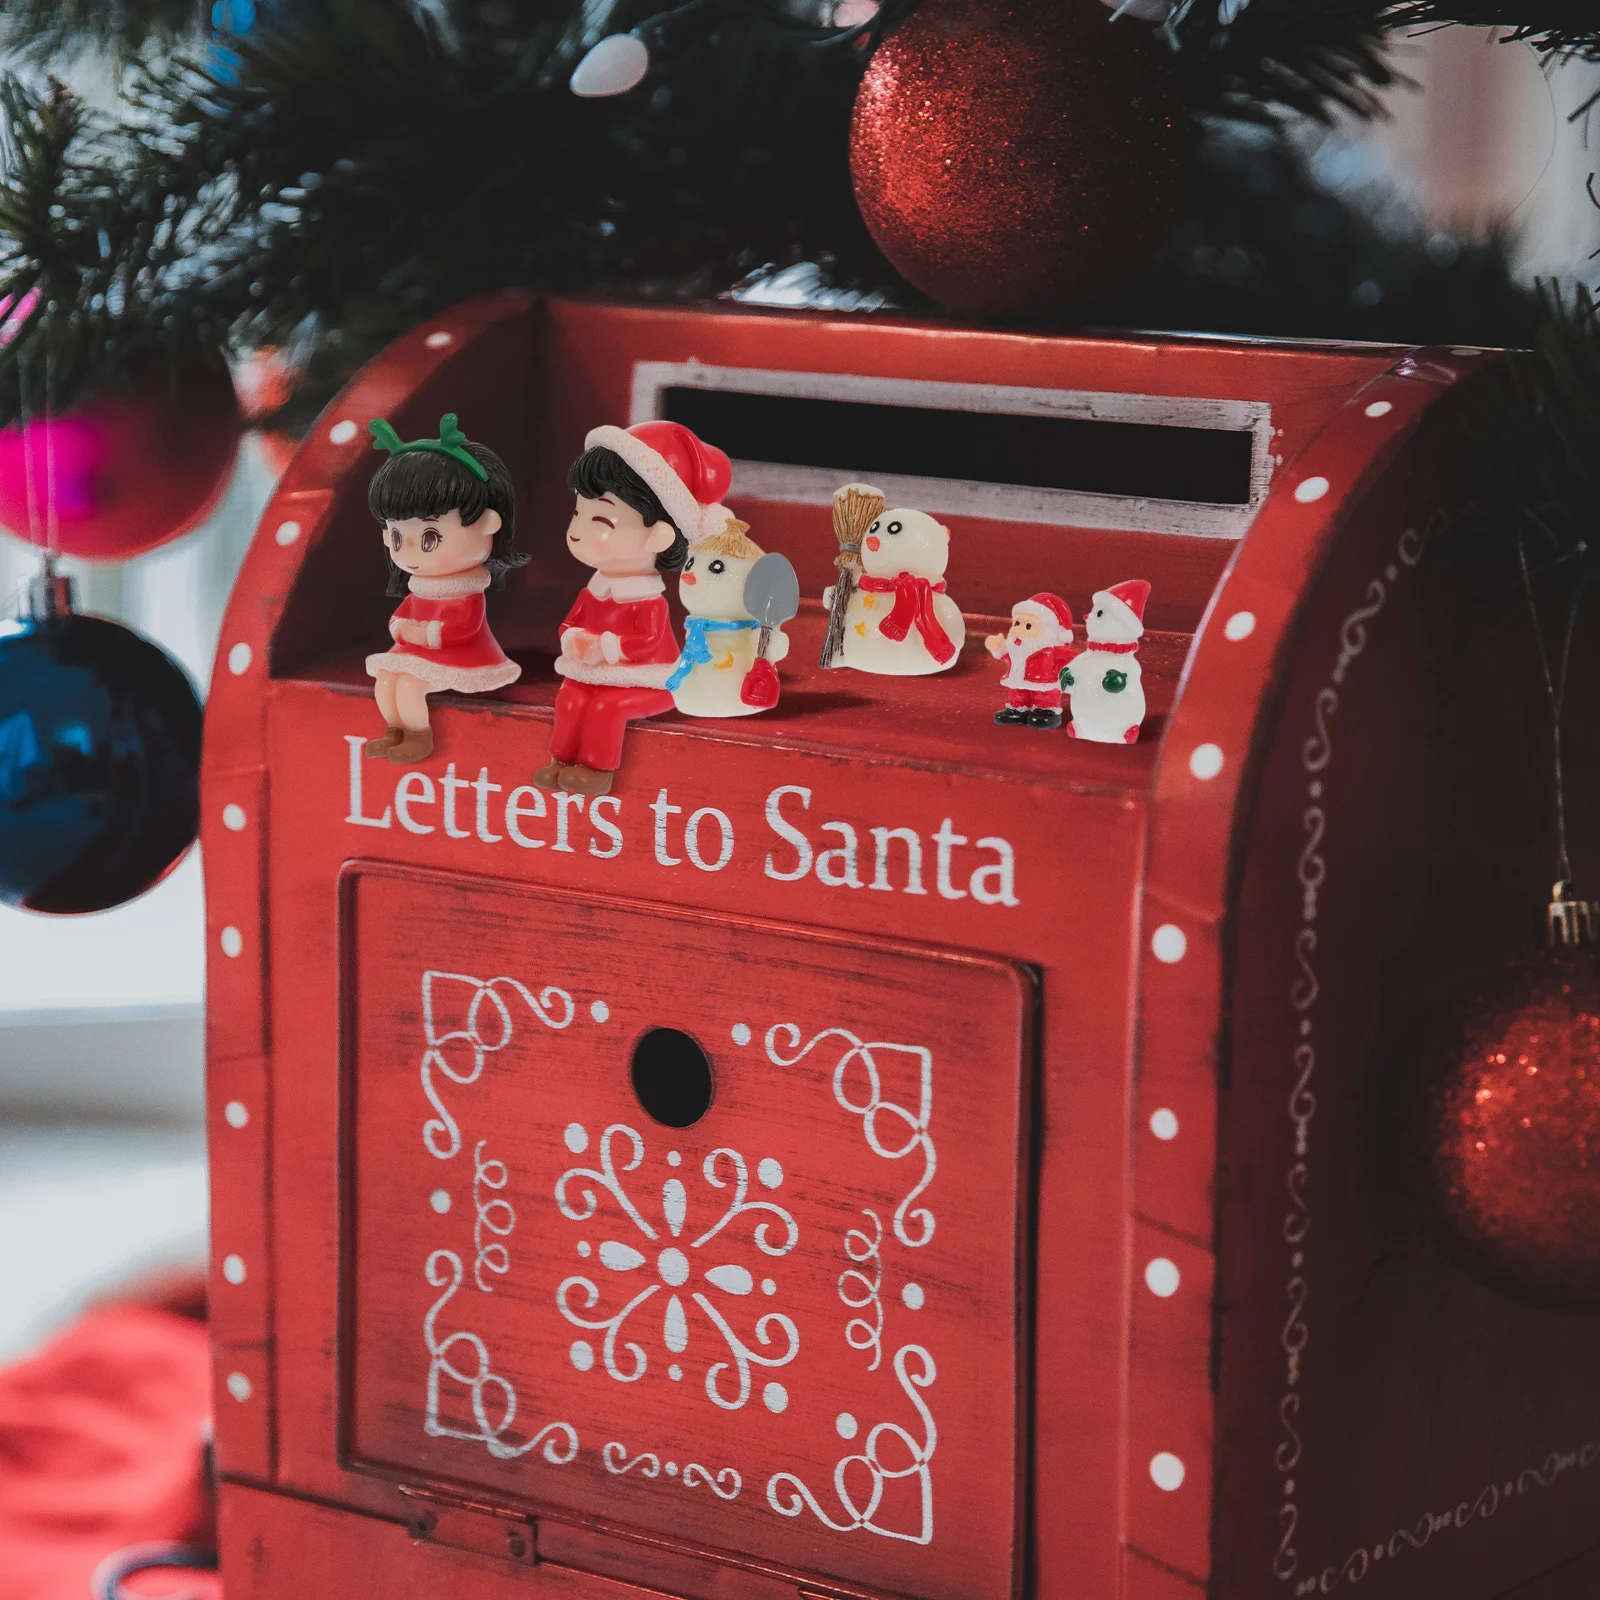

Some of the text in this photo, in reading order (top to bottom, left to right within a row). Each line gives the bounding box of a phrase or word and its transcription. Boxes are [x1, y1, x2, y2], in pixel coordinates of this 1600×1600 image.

[344, 735, 1020, 907] Letters to Santa
